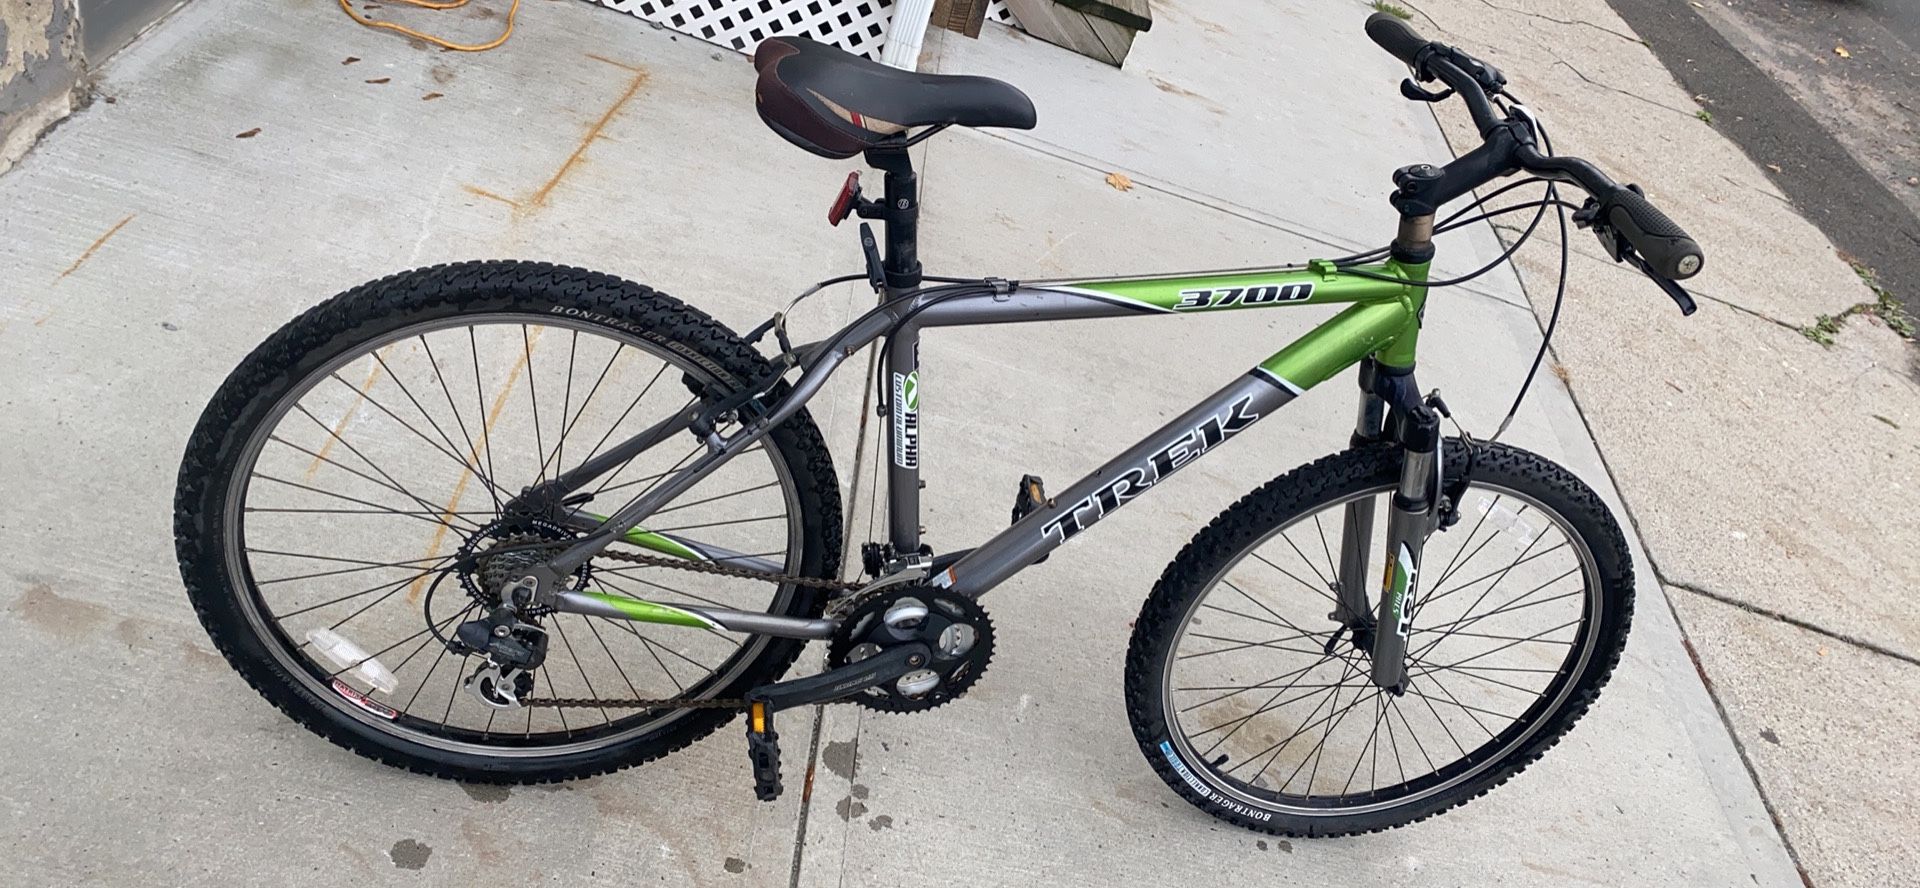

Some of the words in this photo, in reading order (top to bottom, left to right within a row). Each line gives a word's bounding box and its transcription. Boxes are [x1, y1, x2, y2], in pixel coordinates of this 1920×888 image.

[1174, 281, 1314, 311] 3700
[549, 304, 666, 343] BONTRAGER
[895, 374, 903, 412] CUSTOM
[895, 413, 903, 465] ALUMINUM
[905, 412, 917, 467] ALPHA
[1040, 392, 1259, 544] TREK
[532, 519, 572, 538] MEGADRIVE
[1208, 791, 1272, 823] BONTRAGER
